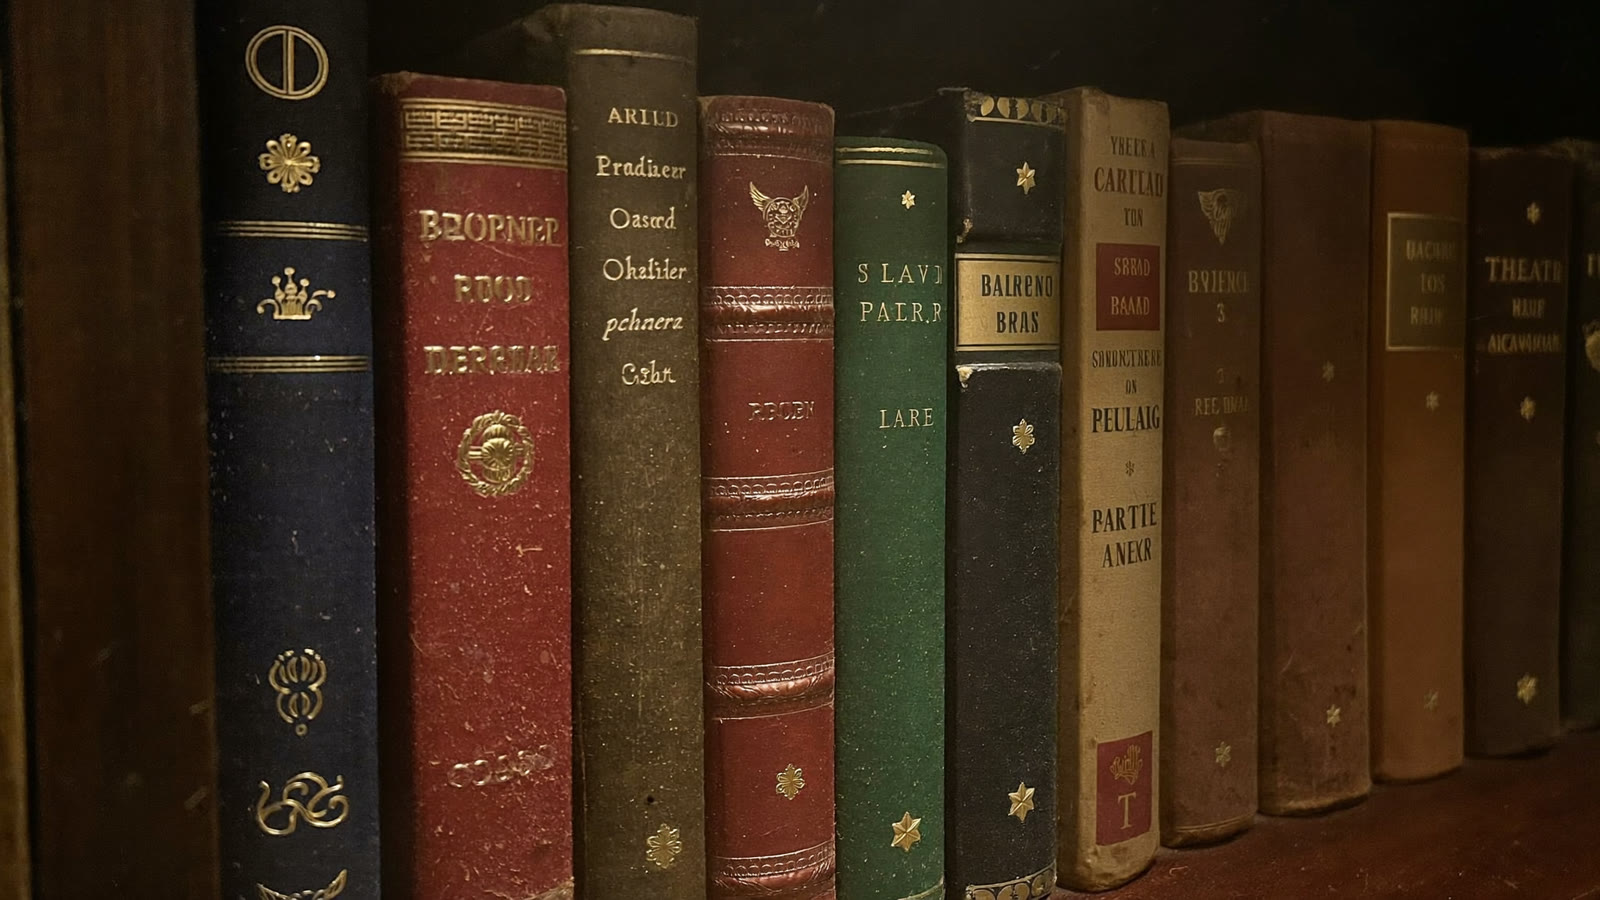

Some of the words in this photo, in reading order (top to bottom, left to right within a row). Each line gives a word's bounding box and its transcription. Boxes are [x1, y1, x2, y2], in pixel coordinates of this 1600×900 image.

[997, 311, 1039, 333] BRAS
[879, 408, 935, 429] LARE
[1117, 791, 1137, 830] T
